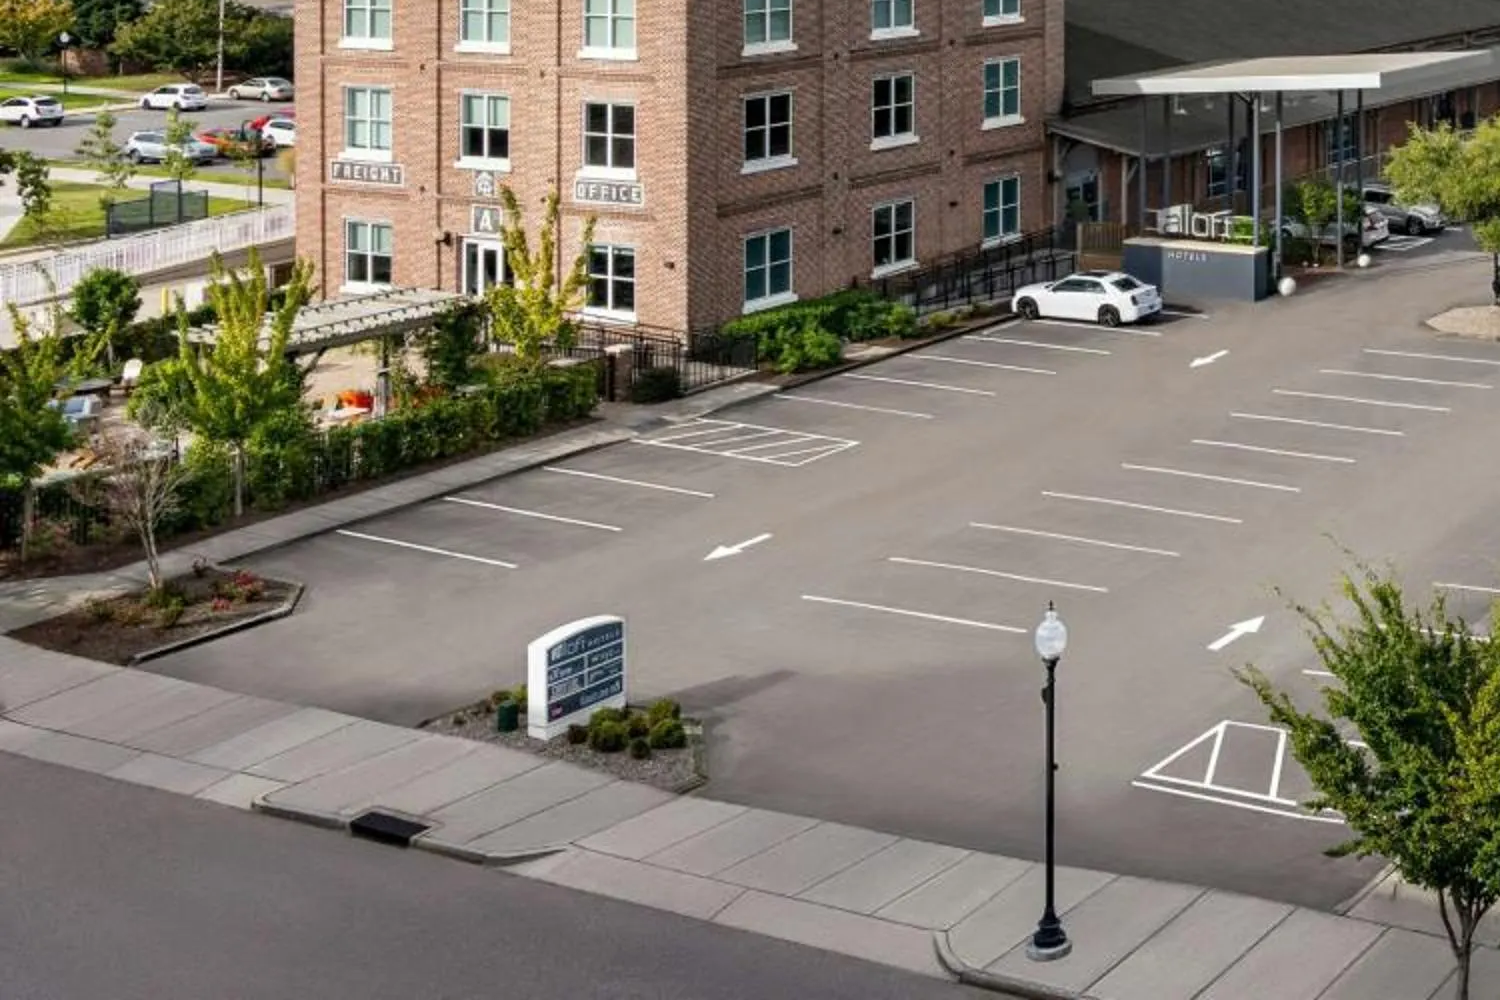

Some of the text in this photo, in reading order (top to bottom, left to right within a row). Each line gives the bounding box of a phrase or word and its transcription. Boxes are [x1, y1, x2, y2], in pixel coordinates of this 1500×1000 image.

[332, 163, 400, 183] FREIGHT
[576, 182, 641, 201] OFFICE
[479, 207, 493, 232] A
[1157, 204, 1232, 239] aloft
